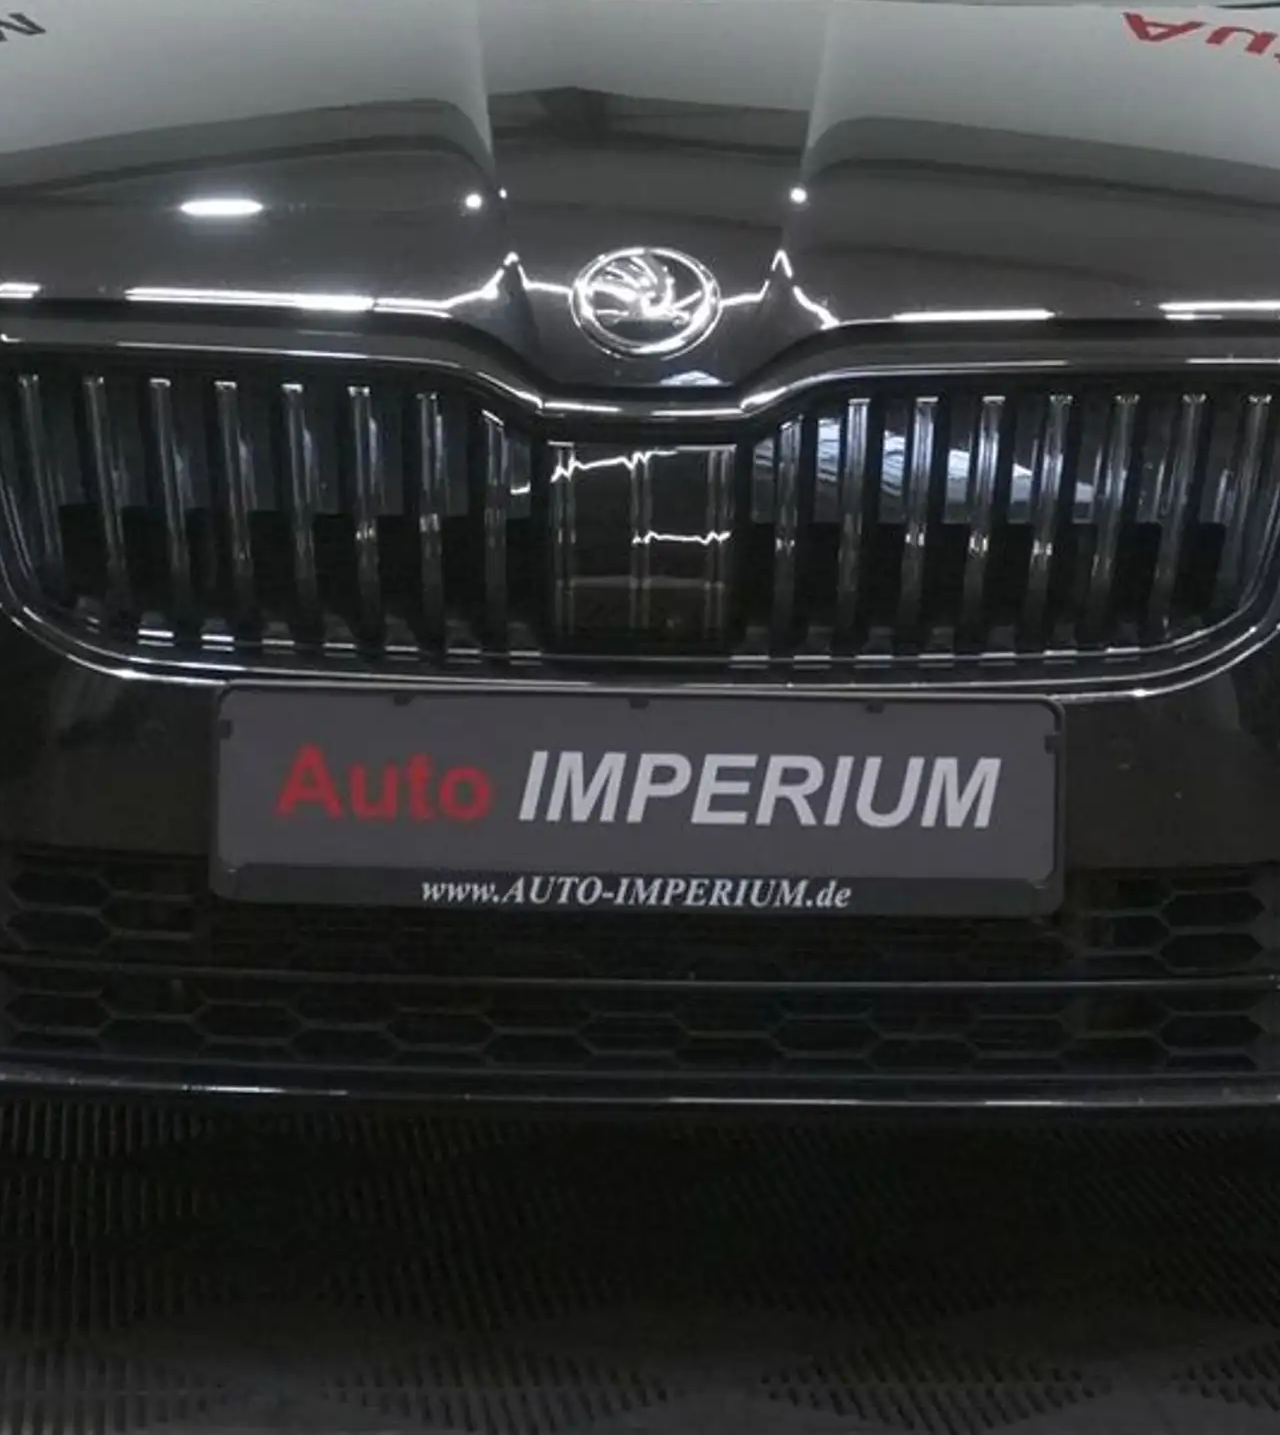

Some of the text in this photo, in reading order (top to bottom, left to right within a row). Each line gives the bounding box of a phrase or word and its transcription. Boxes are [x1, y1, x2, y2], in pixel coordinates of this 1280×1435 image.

[274, 743, 1001, 827] Auto IMPERIUM
[423, 877, 851, 907] www.AUTO-IMPERIUM.de
